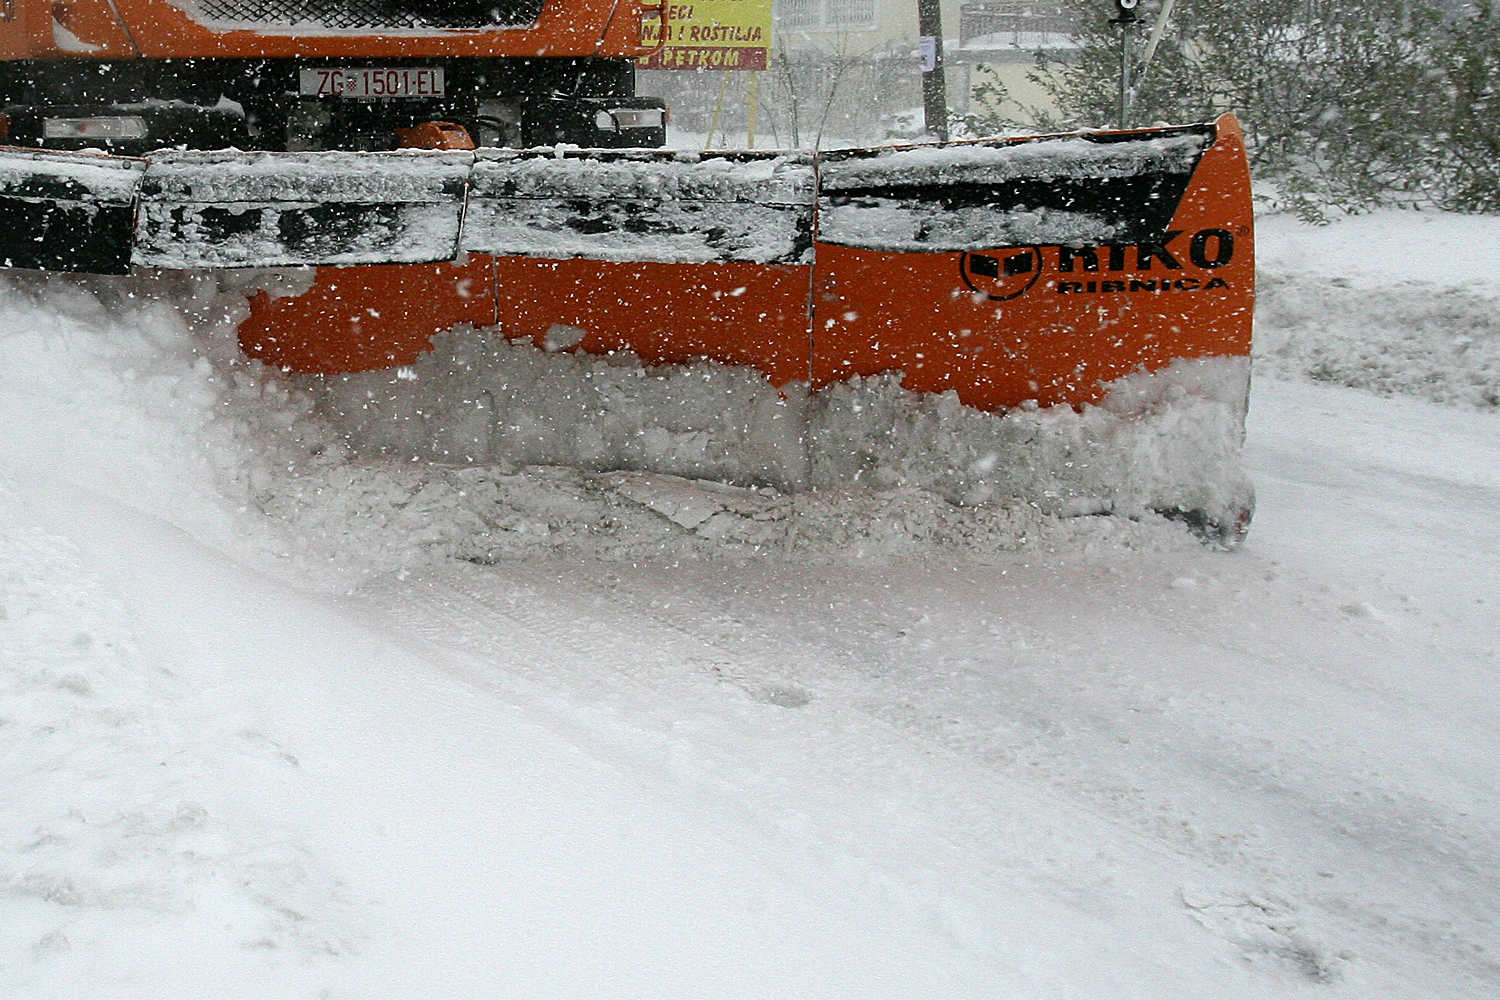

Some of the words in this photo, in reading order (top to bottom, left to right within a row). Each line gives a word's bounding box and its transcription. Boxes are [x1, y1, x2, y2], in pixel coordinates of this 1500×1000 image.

[690, 22, 762, 42] ROŠTILJA
[662, 49, 740, 67] PETKOM
[317, 71, 344, 95] ZG
[1059, 228, 1235, 273] RIKO
[1057, 277, 1231, 294] RIBNICA
